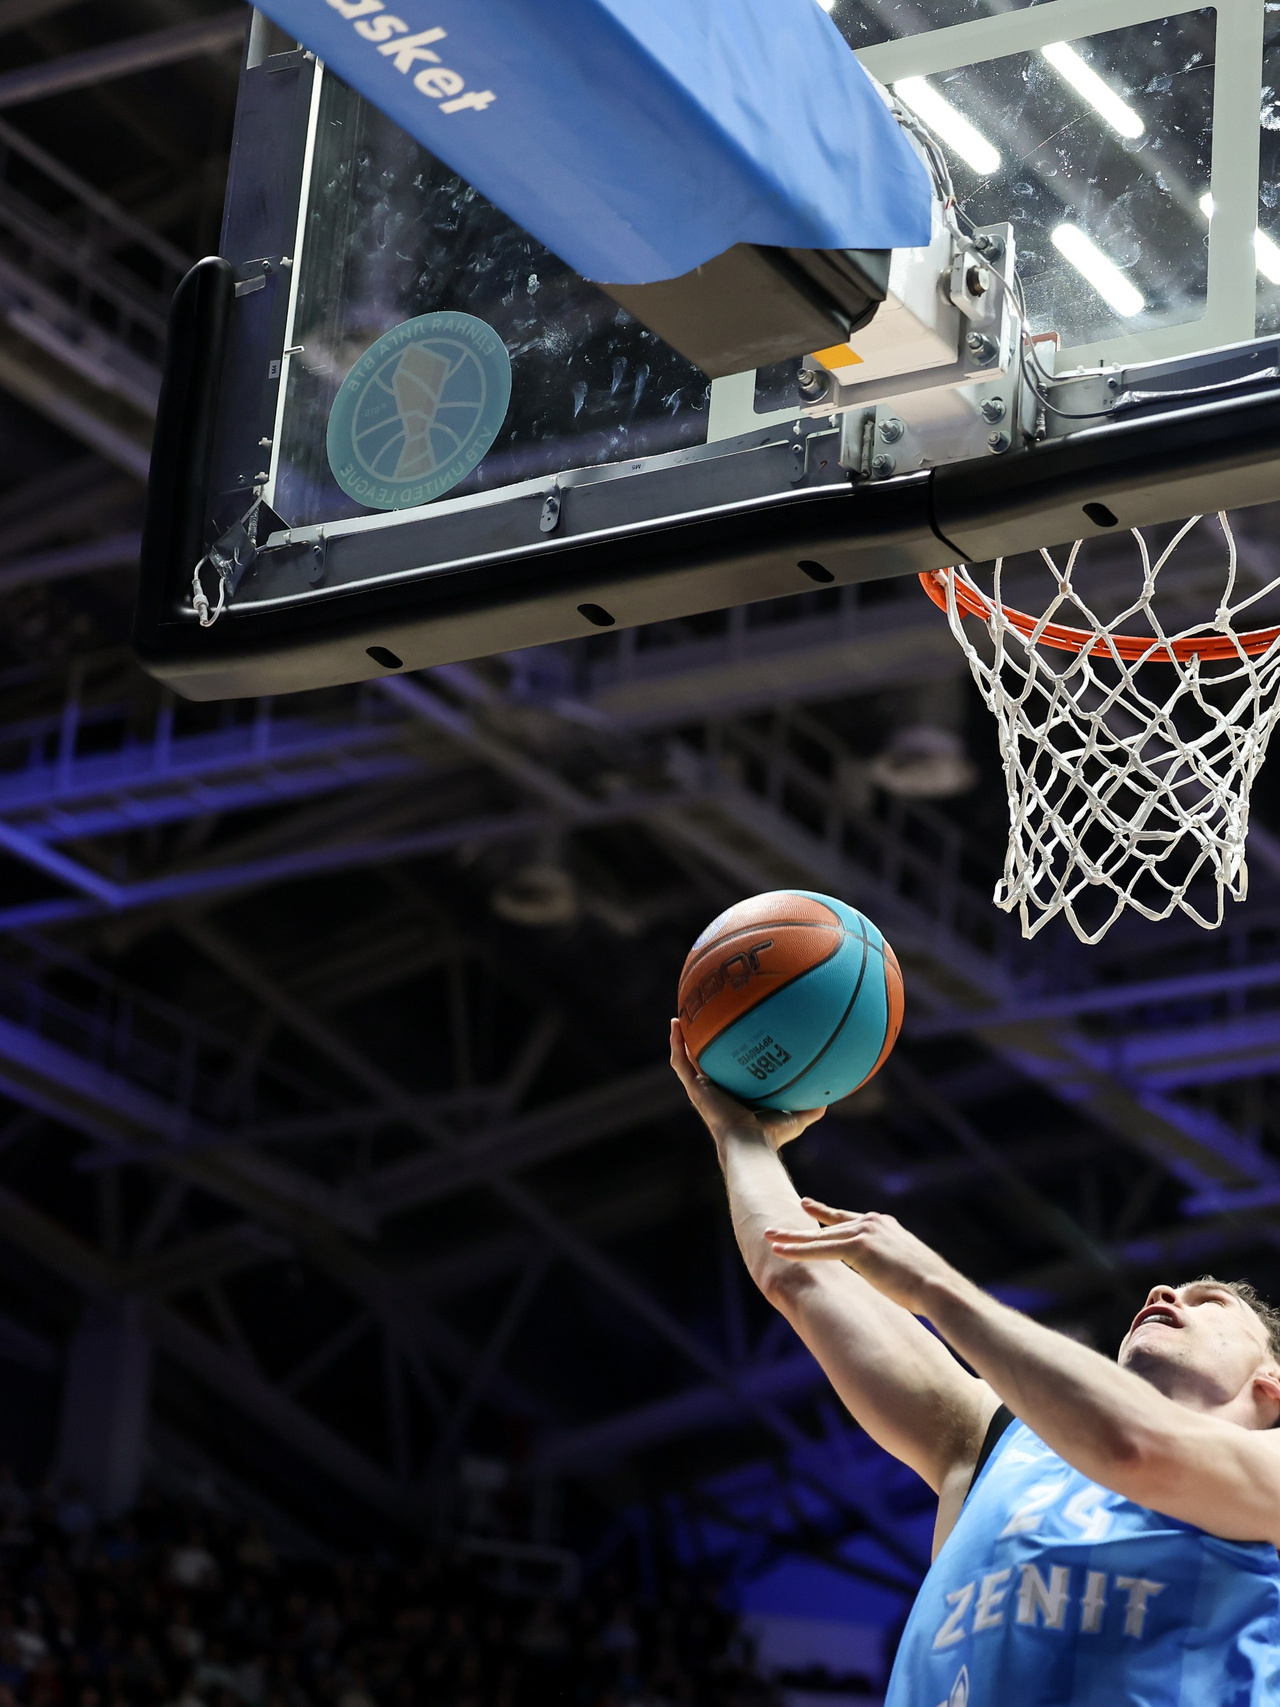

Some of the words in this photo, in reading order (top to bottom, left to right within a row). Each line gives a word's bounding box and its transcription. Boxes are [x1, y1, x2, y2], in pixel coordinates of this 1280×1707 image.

[738, 1035, 773, 1065] APPROVED
[746, 1043, 792, 1080] FIBA
[932, 1563, 1168, 1650] ZENIT
